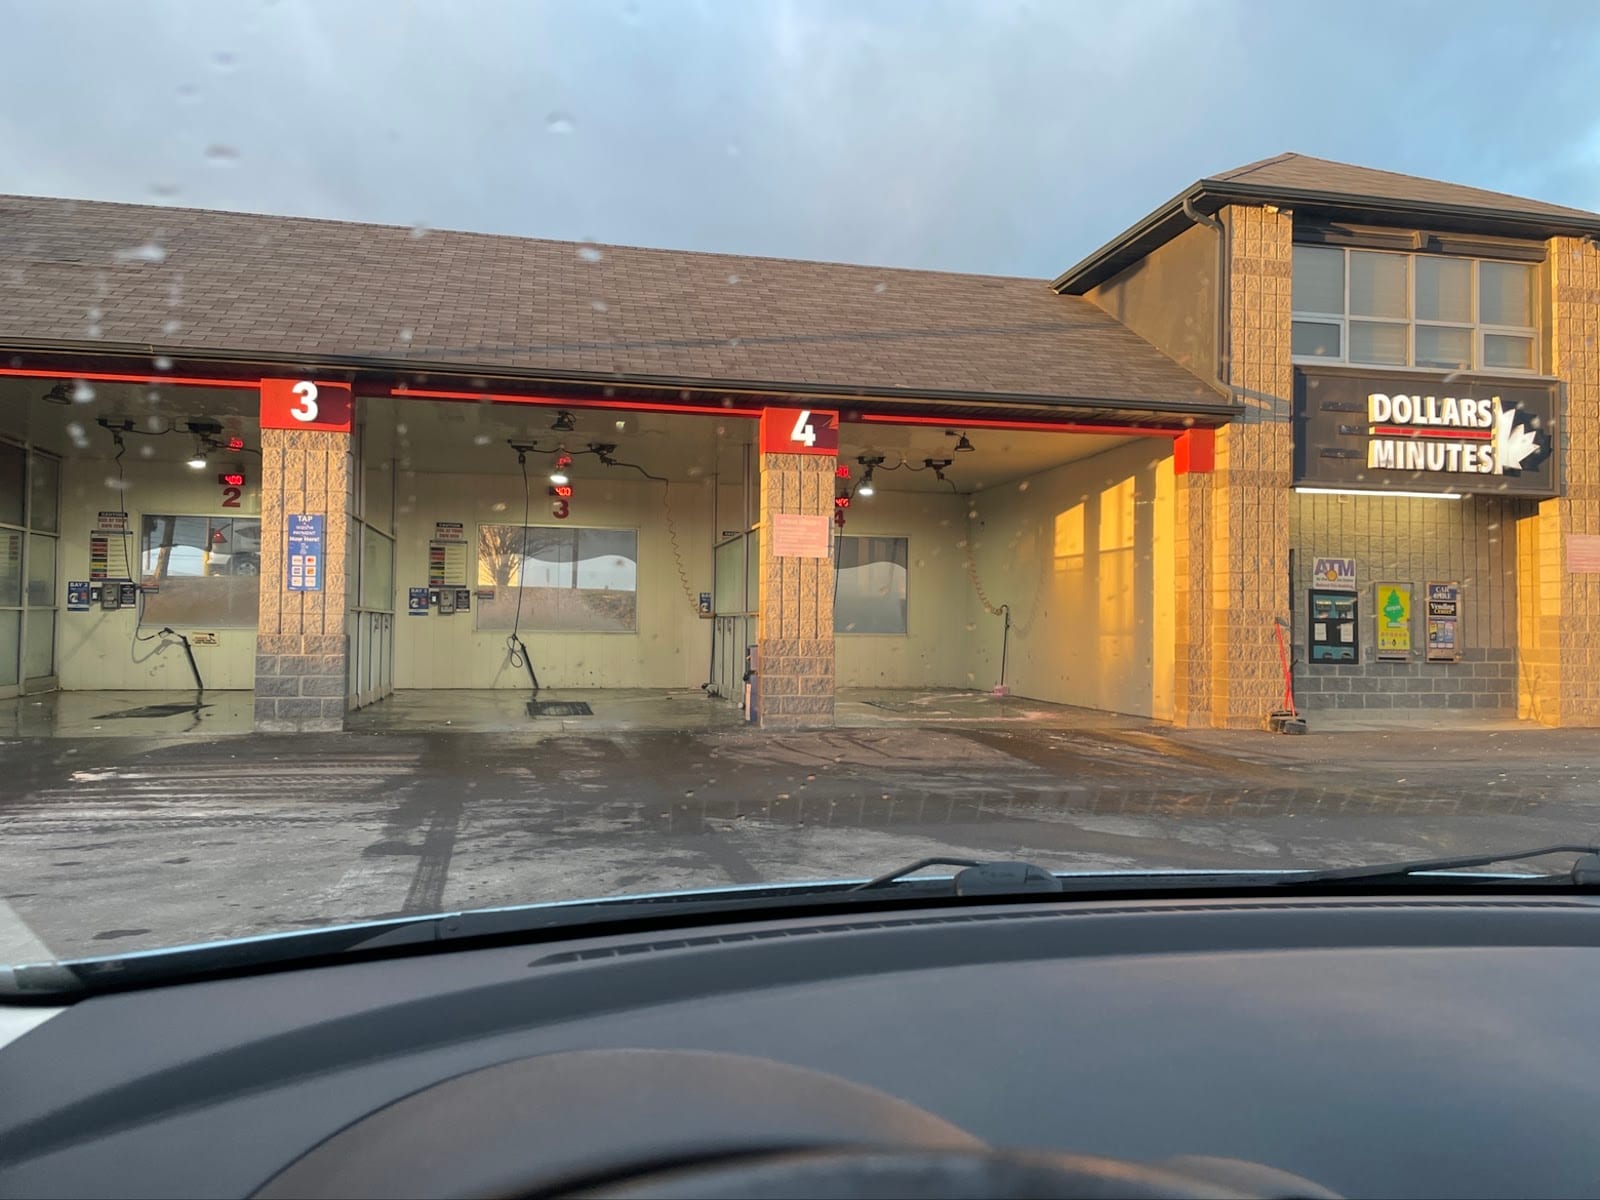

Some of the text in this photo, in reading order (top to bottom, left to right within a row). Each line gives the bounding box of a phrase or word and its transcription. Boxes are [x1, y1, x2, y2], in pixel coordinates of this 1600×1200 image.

[290, 381, 318, 421] 3
[1368, 394, 1493, 428] DOLLARS
[791, 410, 816, 446] 4
[1368, 440, 1494, 474] MINUTES
[222, 487, 241, 507] 2
[552, 499, 569, 519] 3
[1314, 559, 1355, 576] ATM
